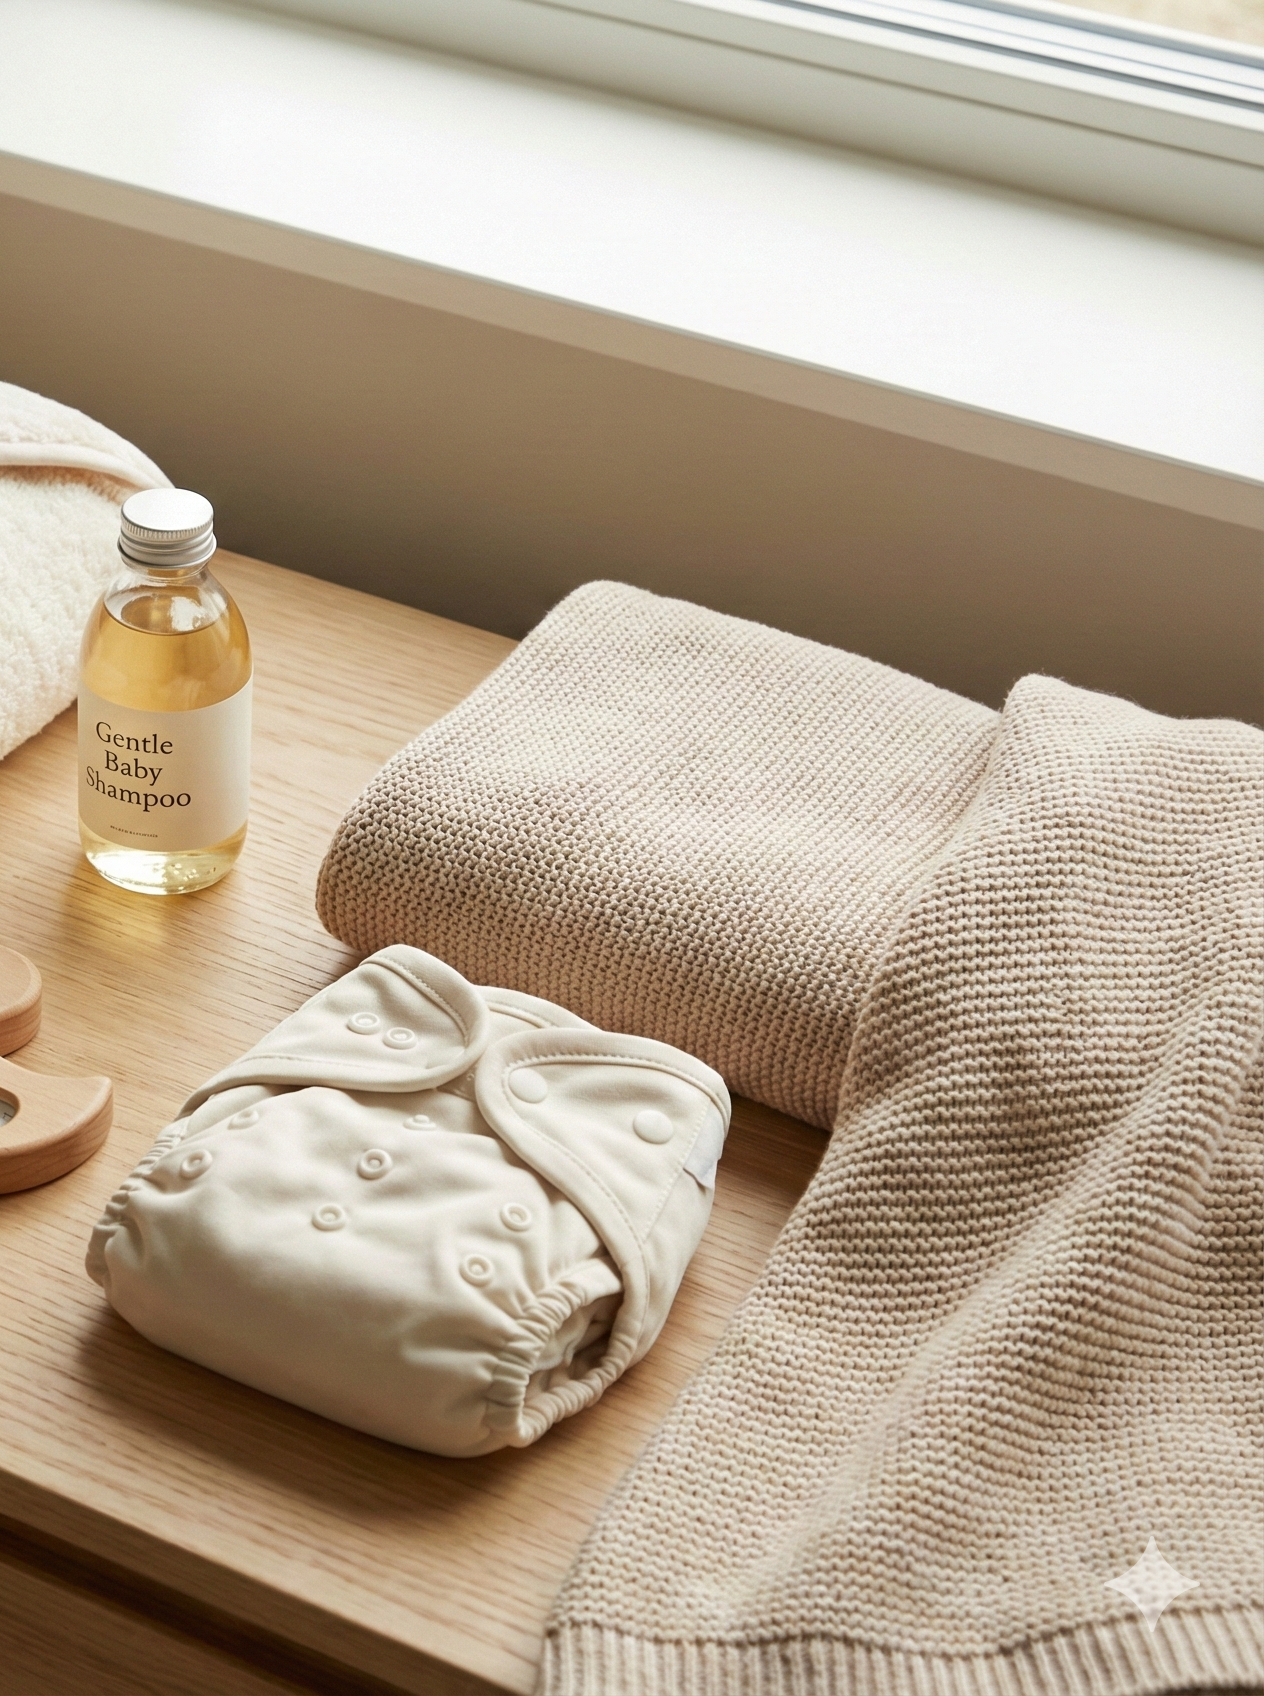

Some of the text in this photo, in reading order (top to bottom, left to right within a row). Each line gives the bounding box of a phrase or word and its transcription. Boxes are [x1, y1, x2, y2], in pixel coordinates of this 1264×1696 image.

[95, 721, 174, 755] Gentle
[104, 749, 164, 787] Baby
[86, 766, 192, 813] Shampoo
